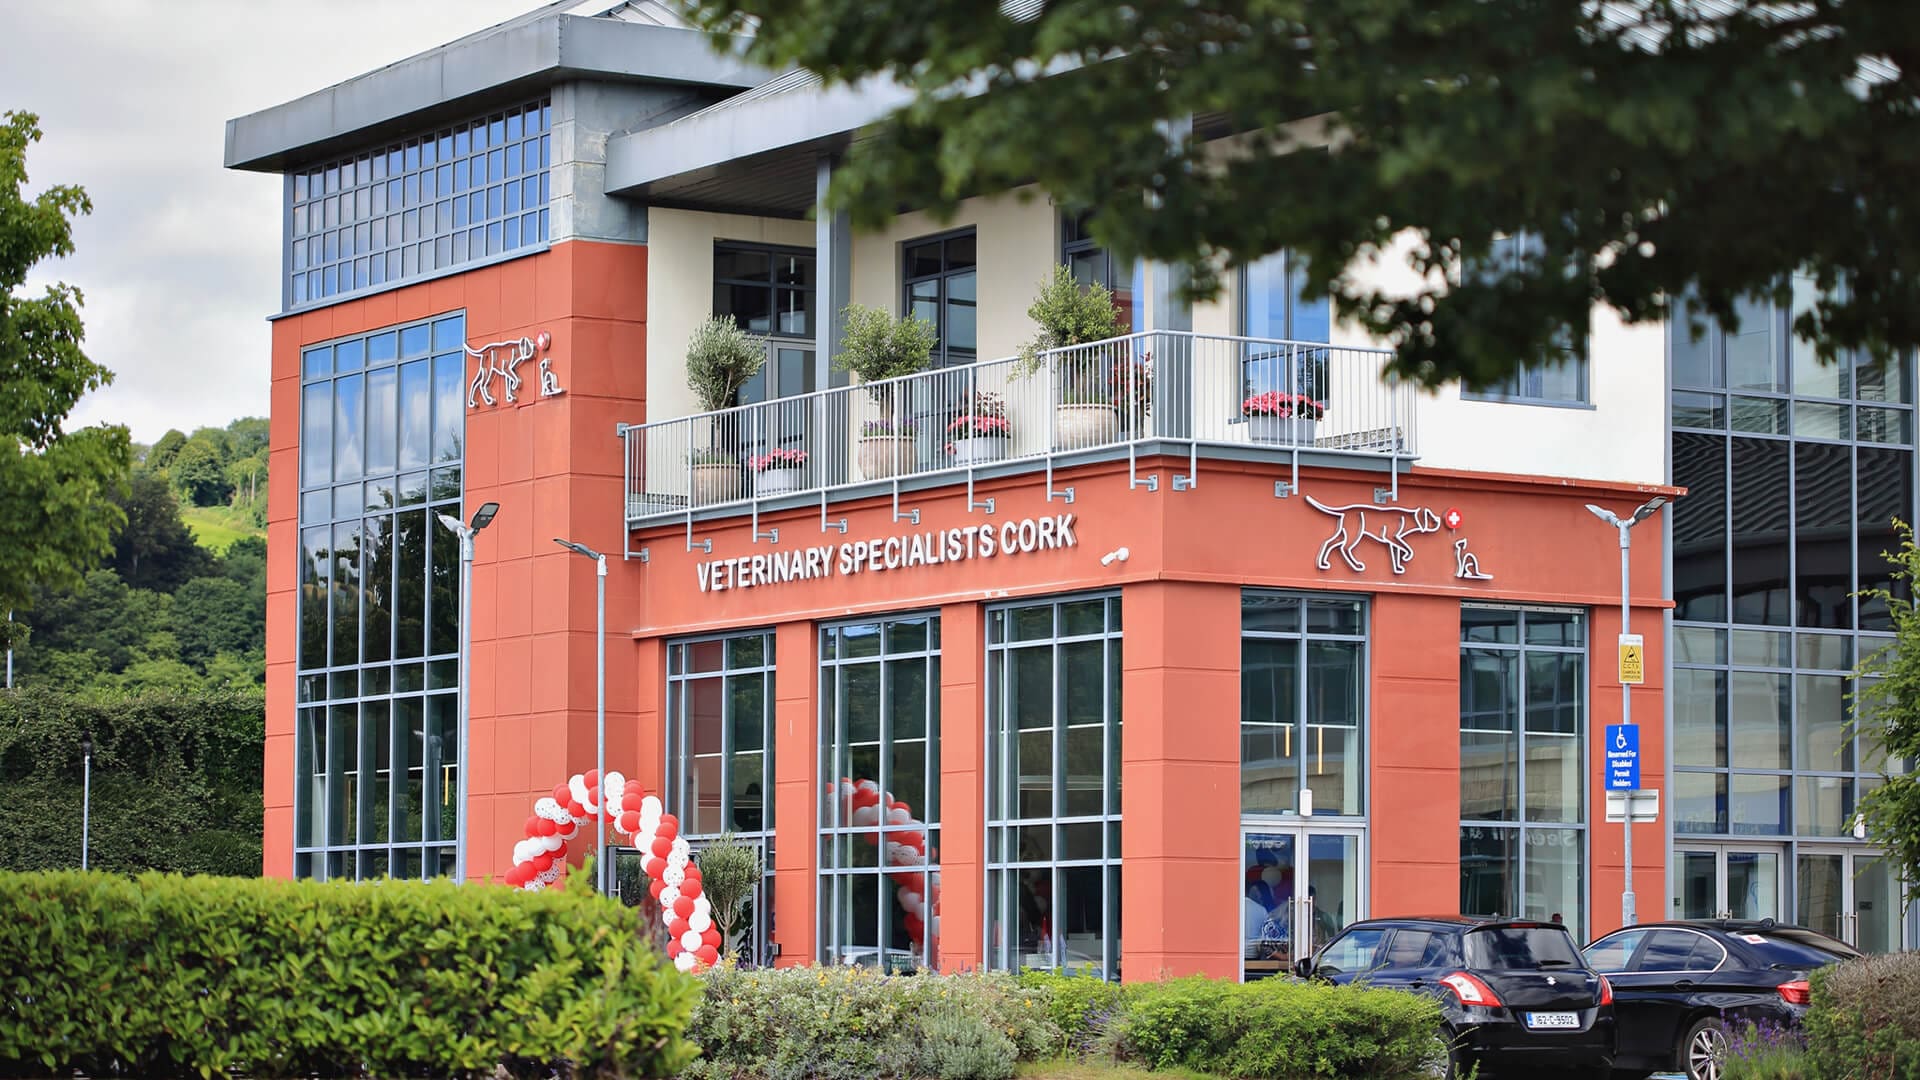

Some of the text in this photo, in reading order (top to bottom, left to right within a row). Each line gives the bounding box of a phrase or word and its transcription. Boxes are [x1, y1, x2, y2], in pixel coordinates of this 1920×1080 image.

[697, 513, 1076, 592] VETERINARY SPECIALISTS CORK
[1611, 759, 1632, 768] Disabled
[1614, 769, 1630, 777] Permit
[1612, 779, 1632, 787] Holders
